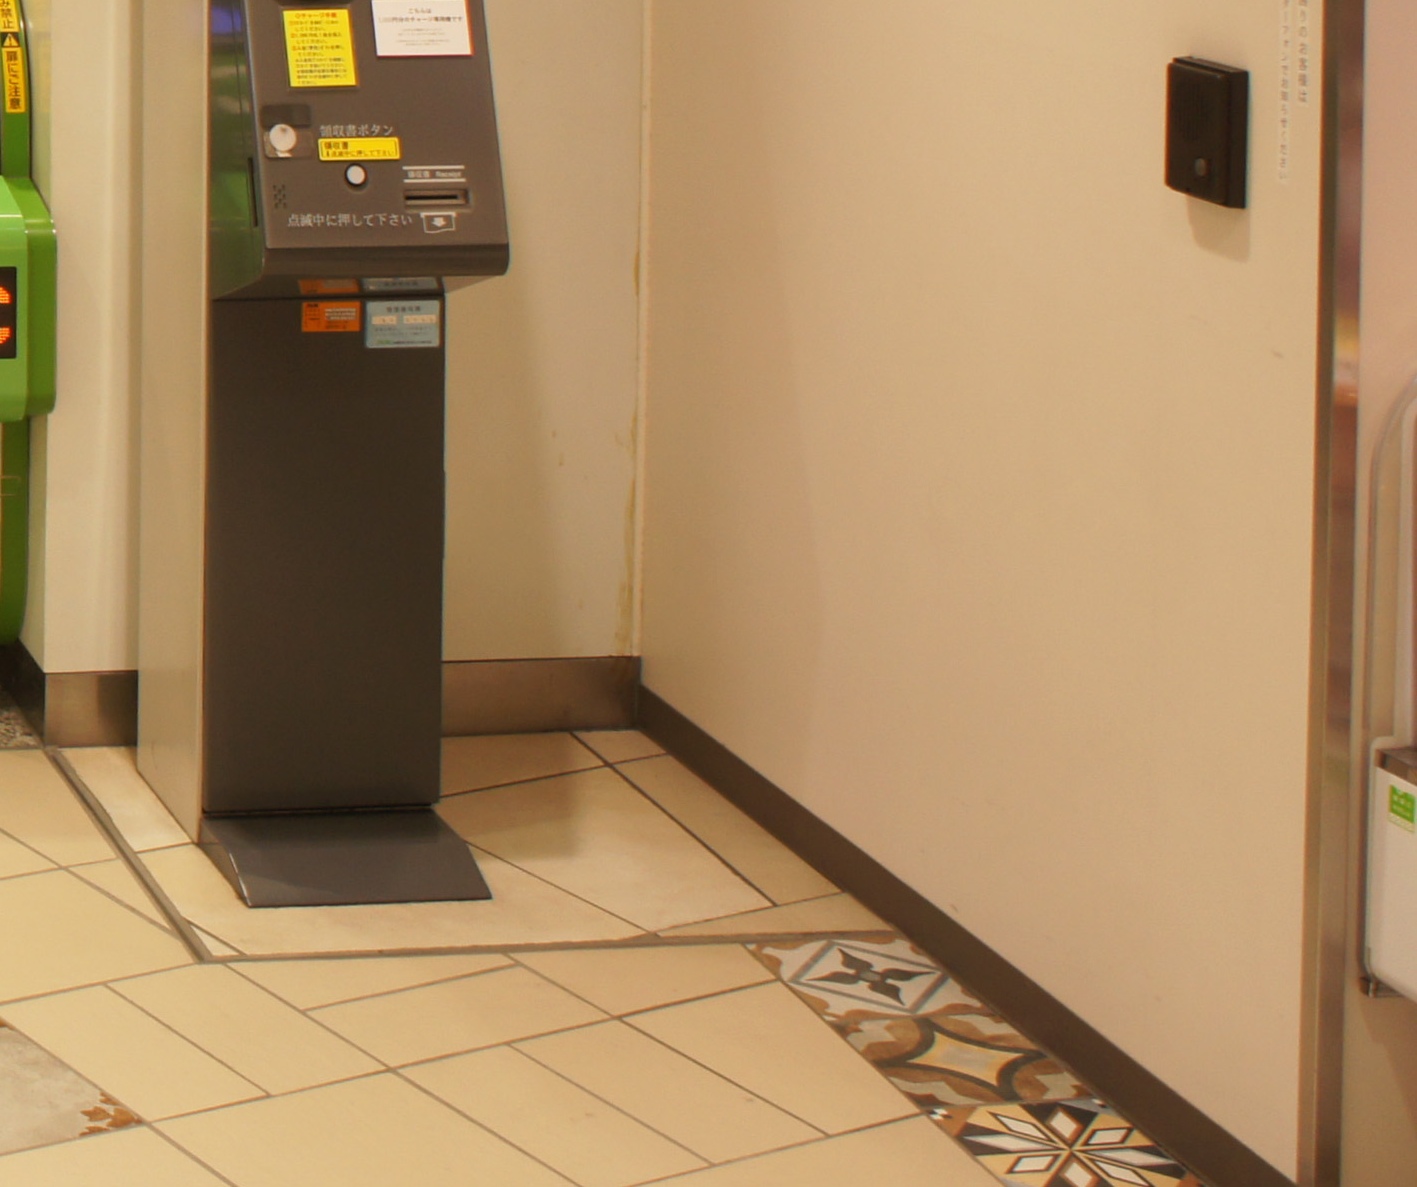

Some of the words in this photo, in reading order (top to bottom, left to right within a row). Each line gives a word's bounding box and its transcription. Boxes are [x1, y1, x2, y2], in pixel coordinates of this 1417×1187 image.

[5, 51, 21, 110] 扉にご注意
[320, 124, 394, 137] 領収書ボタン
[287, 214, 413, 228] 点滅中に押して下さい
